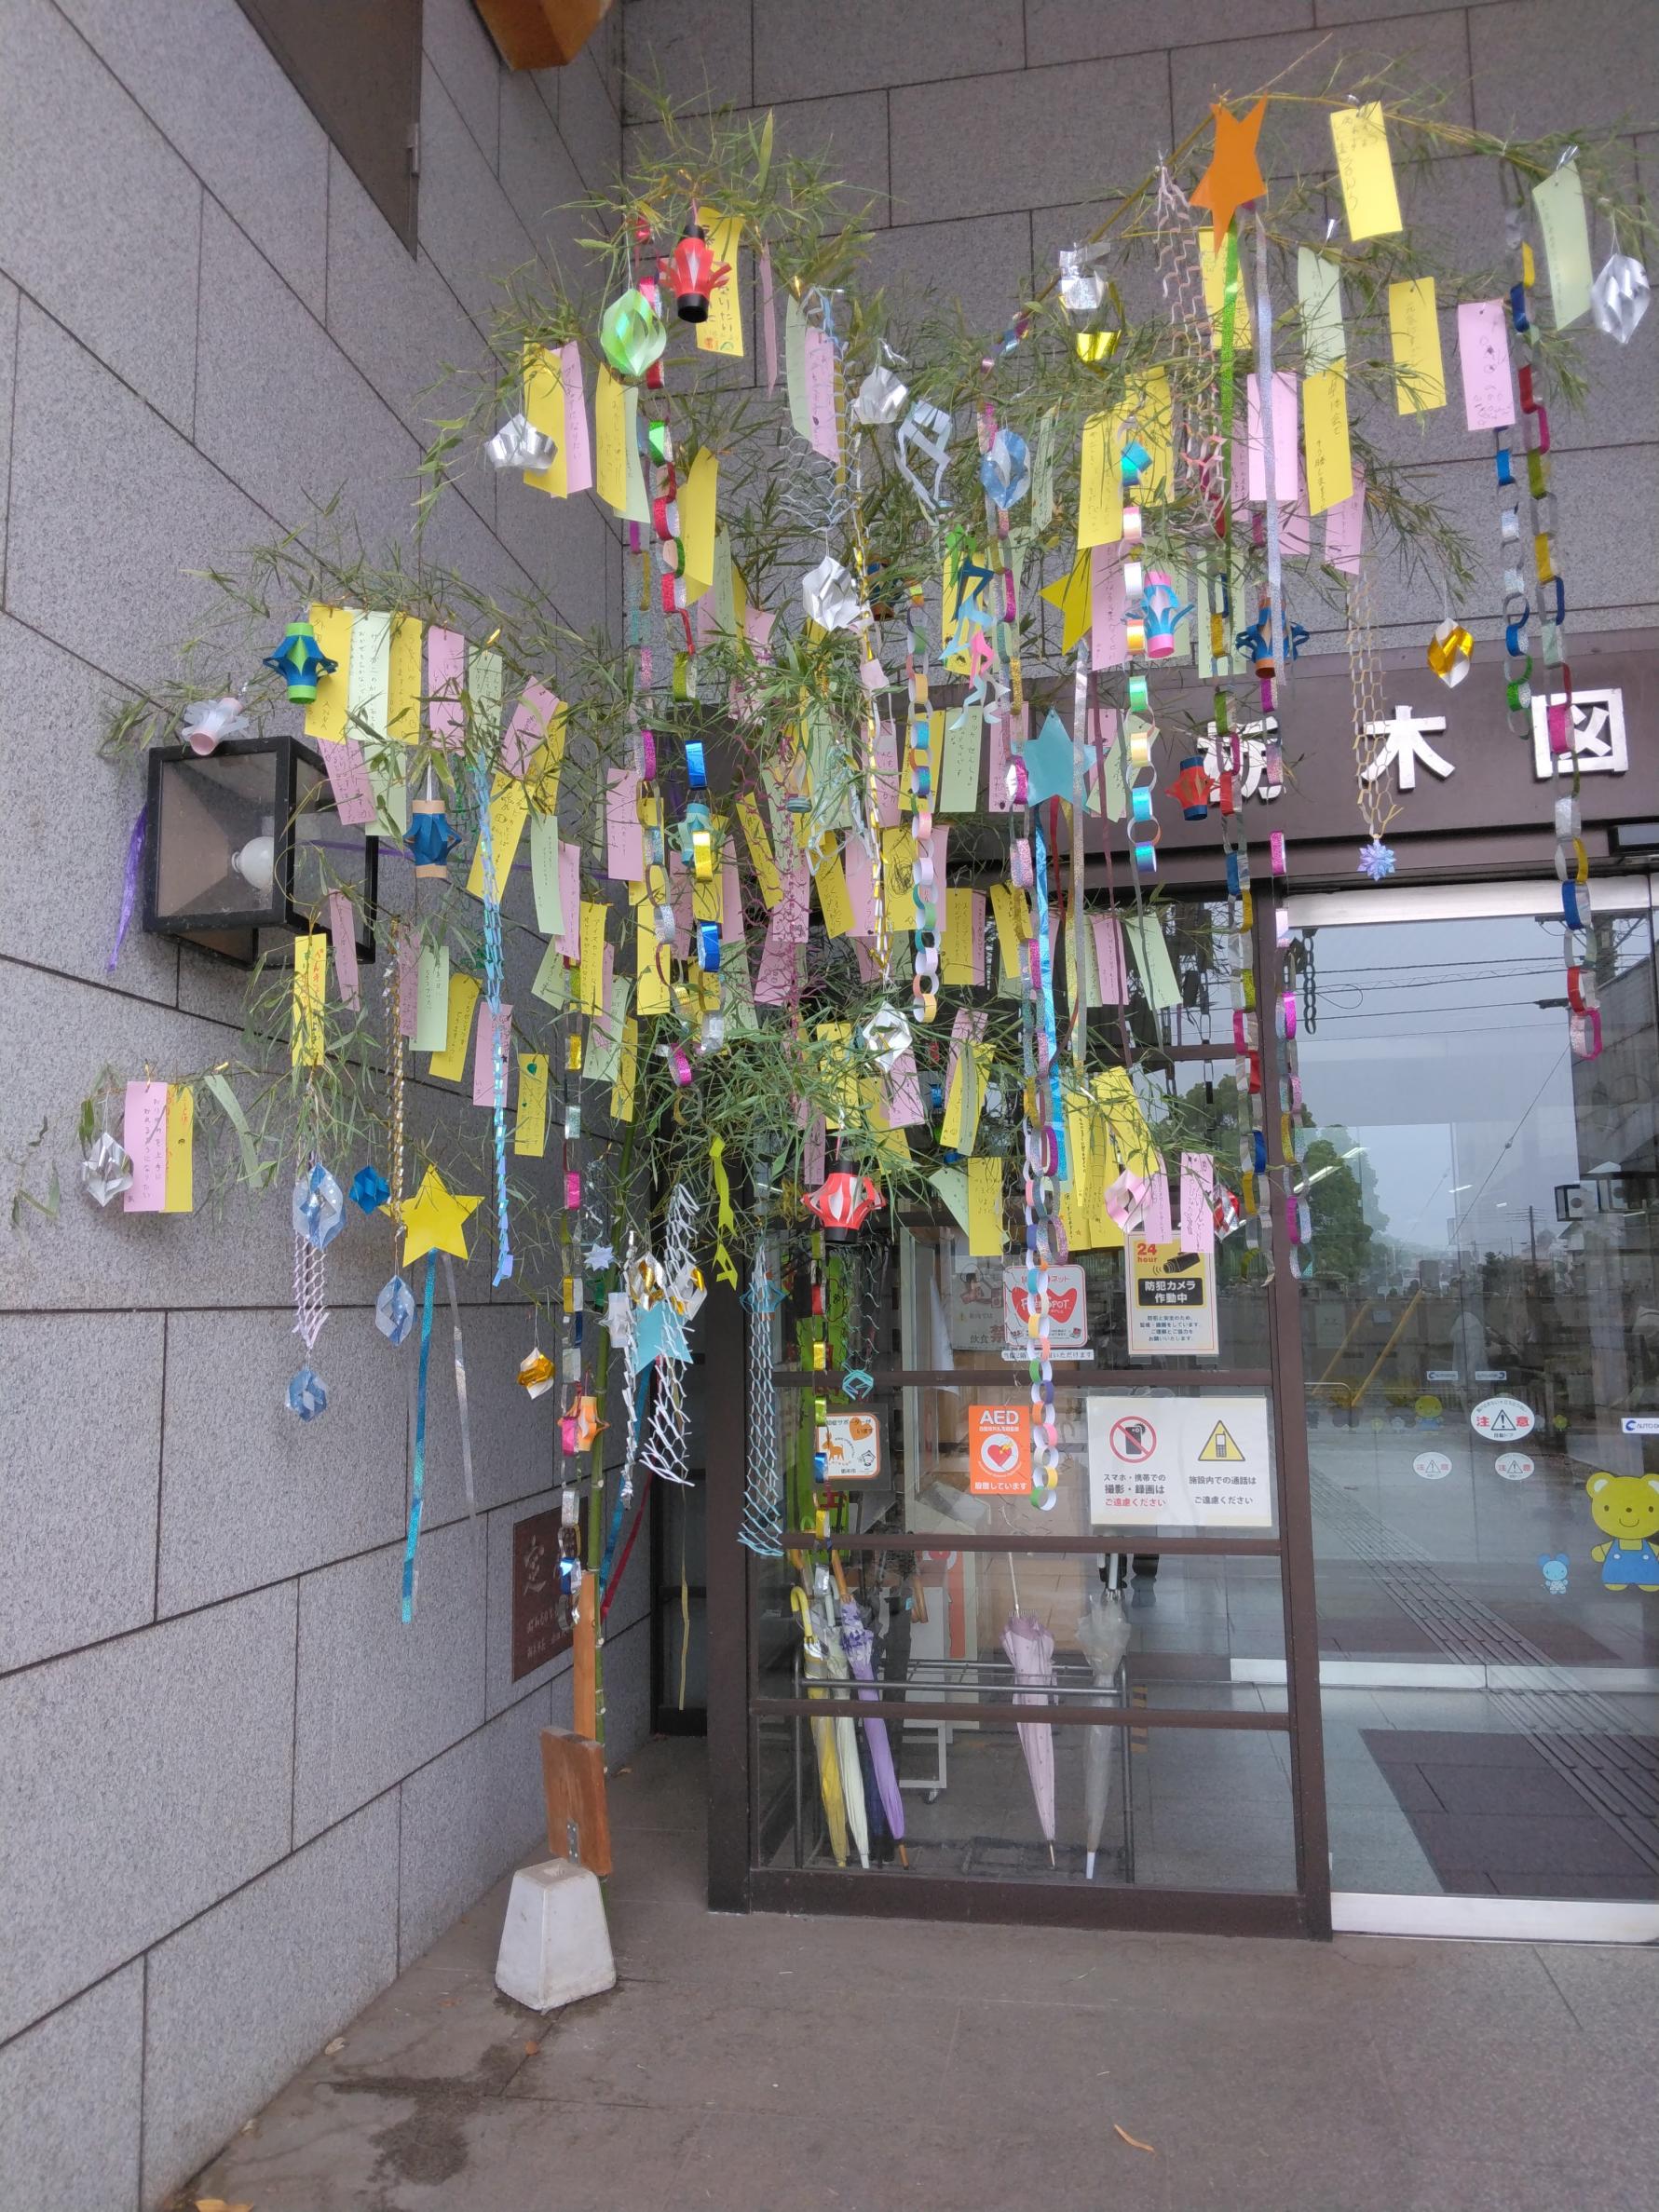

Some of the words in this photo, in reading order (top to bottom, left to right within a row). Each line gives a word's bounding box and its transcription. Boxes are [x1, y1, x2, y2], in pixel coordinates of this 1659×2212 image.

[1137, 1242, 1158, 1255] 24
[1145, 1281, 1196, 1292] 防犯カメラ
[1155, 1292, 1188, 1304] 作動中
[979, 1410, 1020, 1425] AED
[1104, 1473, 1166, 1482] スマホ・携帯での
[1189, 1475, 1257, 1486] 施設内での通話は
[974, 1481, 1027, 1490] 設置しています
[1105, 1485, 1165, 1495] 撮影・録画は
[1105, 1498, 1166, 1507] ご遠慮ください
[1194, 1496, 1254, 1505] ご遠慮ください
